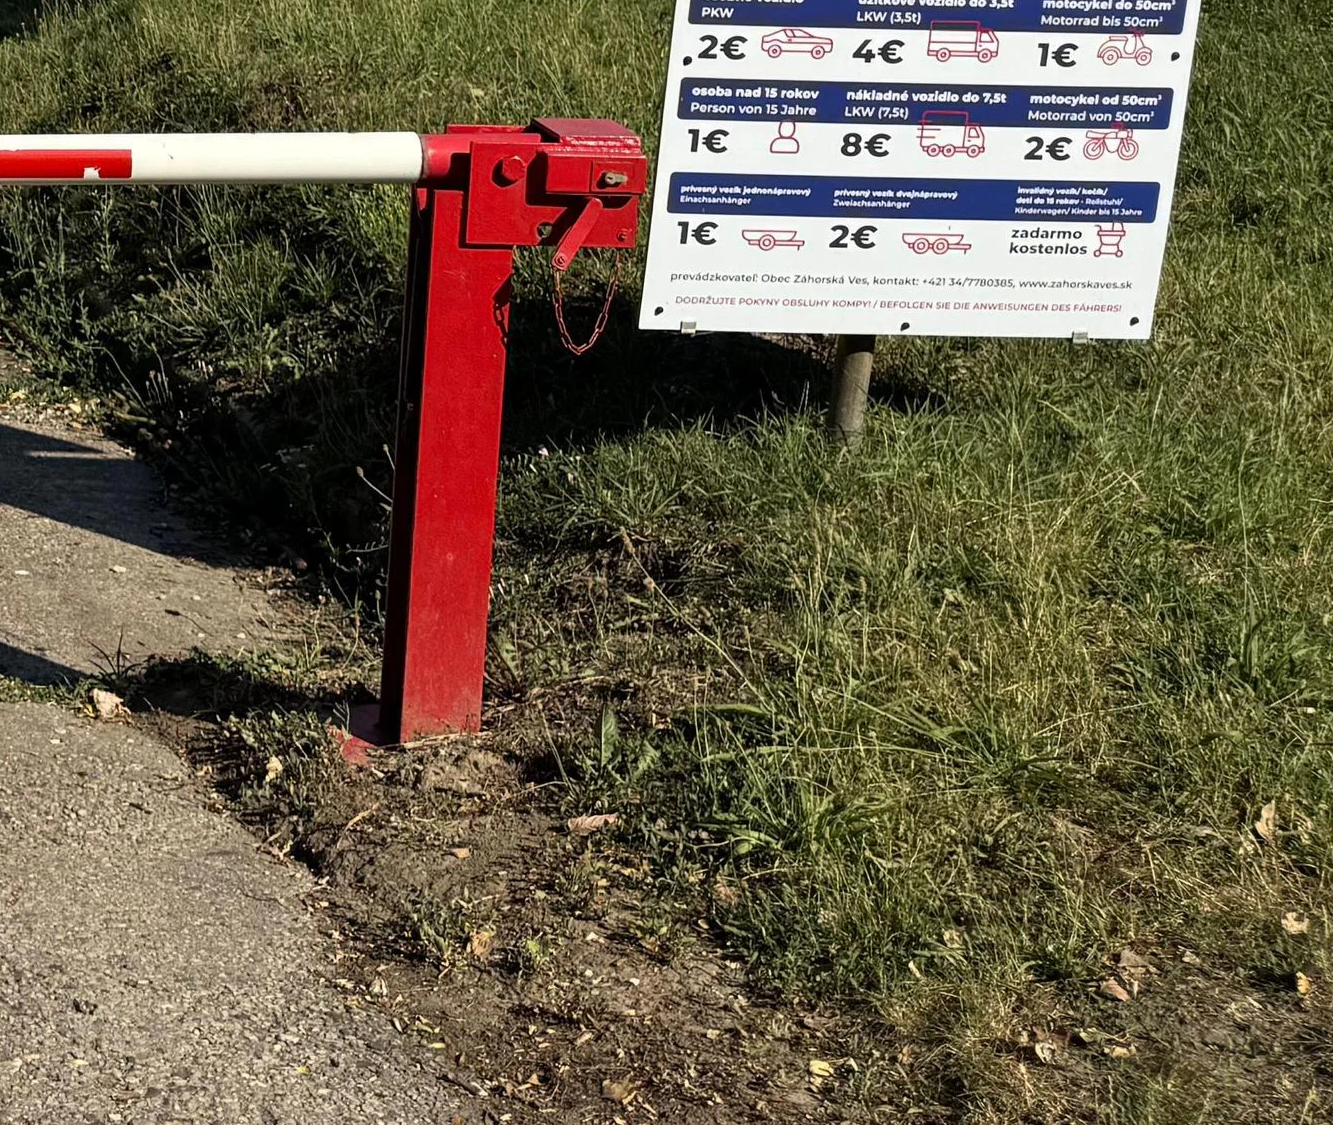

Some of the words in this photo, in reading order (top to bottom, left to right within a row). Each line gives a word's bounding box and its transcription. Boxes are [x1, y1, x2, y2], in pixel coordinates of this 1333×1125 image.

[1043, 0, 1112, 11] motocykel
[1115, 0, 1132, 9] do
[701, 8, 734, 17] PKW
[857, 12, 887, 22] LKW
[890, 12, 921, 24] (3,5t)
[1041, 15, 1098, 26] Motorrad
[1102, 16, 1121, 26] bis
[698, 35, 748, 60] 2€
[852, 39, 905, 64] 4€
[1038, 43, 1079, 67] 1€
[692, 87, 732, 97] osoba
[736, 88, 761, 97] nad
[765, 88, 777, 97] 15
[781, 88, 819, 99] rokov
[847, 90, 908, 101] nákladné
[912, 91, 959, 102] vozidlo
[962, 92, 979, 103] do
[983, 93, 1007, 104] 7,5t
[1030, 94, 1099, 107] motocykel
[1102, 95, 1119, 105] od
[691, 103, 735, 113] Person
[739, 105, 762, 114] von
[766, 105, 778, 114] 15
[781, 105, 816, 115] Jahre
[845, 108, 875, 117] LKW
[878, 108, 909, 119] (7,5t)
[1028, 111, 1086, 121] Motorrad
[1089, 113, 1112, 122] von
[688, 129, 729, 153] 1€
[841, 132, 891, 157] 8€
[1024, 137, 1073, 160] 2€
[680, 196, 751, 205] Einachsanhänger
[833, 200, 910, 209] Zweiachsanhänger
[678, 221, 719, 245] 1€
[829, 225, 878, 249] 2€
[1012, 228, 1082, 239] zadarmo
[1010, 243, 1087, 255] kostenlos
[761, 274, 790, 283] Obec
[794, 275, 844, 284] Záhorská
[849, 276, 870, 286] Ves,
[873, 277, 919, 285] kontakt:
[922, 278, 946, 286] +421
[1019, 280, 1132, 289] www.zahorskaves.sk
[675, 295, 736, 305] DODRŽUJTE
[739, 298, 780, 306] POKYNY
[783, 299, 829, 307] OBSLUHY
[833, 300, 871, 308] KOMPY!
[873, 300, 877, 308] /
[880, 300, 933, 308] BEFOLGEN
[973, 302, 1048, 311] ANWEISUNGEN
